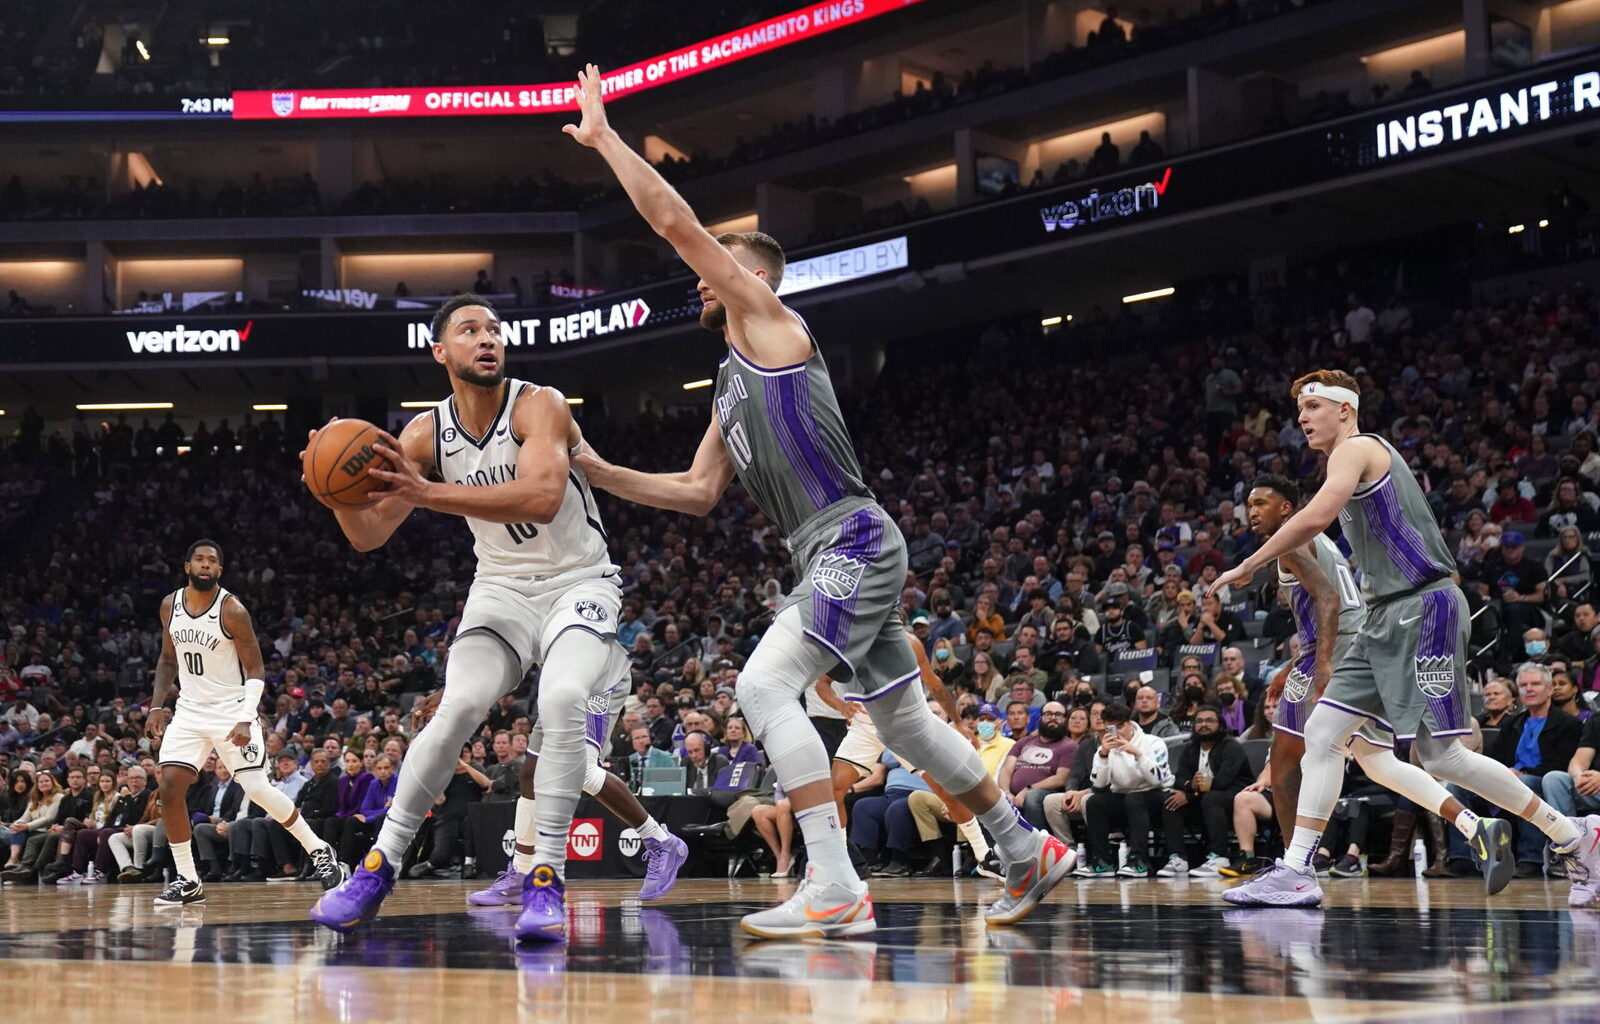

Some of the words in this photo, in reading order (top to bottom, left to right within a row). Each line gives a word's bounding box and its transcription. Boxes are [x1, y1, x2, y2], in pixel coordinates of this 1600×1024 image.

[425, 91, 514, 109] OFFICIAL
[518, 88, 575, 107] SLEEP
[600, 68, 643, 97] RTNER
[646, 60, 668, 81] OF
[668, 50, 698, 73] THE
[701, 14, 809, 64] SACRAMENTO
[813, 0, 865, 27] KINGS
[181, 98, 211, 113] 7:43
[213, 98, 234, 113] PM
[1376, 80, 1558, 159] INSTANT
[876, 241, 906, 269] BY
[550, 300, 641, 344] REPLAY
[126, 324, 240, 353] verizon
[727, 420, 753, 472] 10
[814, 568, 857, 589] KINGS
[1335, 563, 1361, 608] 0
[577, 601, 607, 619] NETS
[1119, 648, 1154, 661] KINGS
[1180, 644, 1215, 654] KINGS
[184, 652, 204, 676] 00
[1417, 672, 1454, 682] KINGS
[571, 834, 600, 848] TNT
[618, 838, 642, 849] TNT
